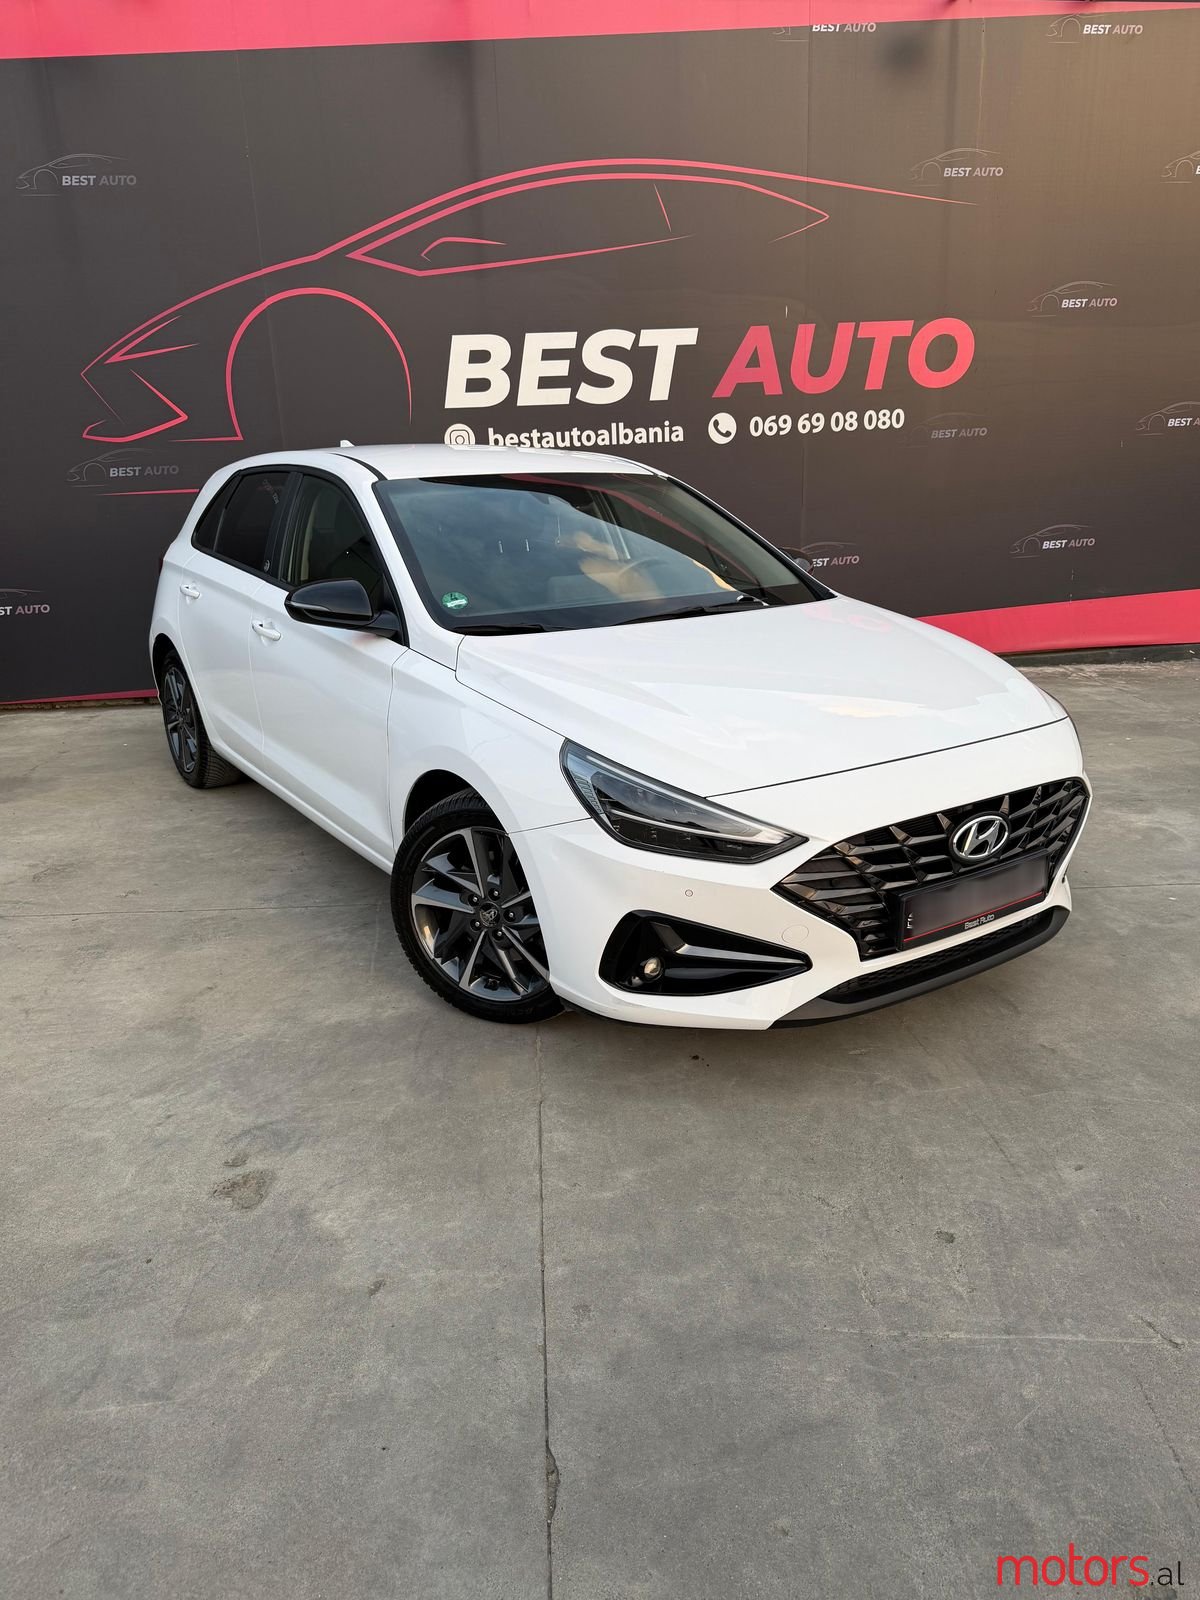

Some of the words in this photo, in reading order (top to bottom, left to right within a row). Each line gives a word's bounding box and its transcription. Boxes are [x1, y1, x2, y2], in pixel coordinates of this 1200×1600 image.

[811, 23, 841, 33] BEST
[844, 22, 876, 33] AUTO
[1082, 25, 1110, 35] BEST
[1112, 25, 1143, 35] AUTO
[943, 167, 971, 178] BEST
[972, 167, 1004, 177] AUTO
[61, 175, 96, 187] BEST
[99, 175, 137, 187] AUTO
[1061, 298, 1088, 309] BEST
[1089, 297, 1118, 308] AUTO
[444, 327, 698, 409] BEST
[713, 317, 976, 398] AUTO
[749, 413, 792, 437] 069
[797, 412, 826, 434] 69
[830, 411, 859, 433] 08
[863, 408, 905, 430] 080
[1167, 417, 1192, 428] BEST
[487, 419, 684, 448] bestautoalbania
[931, 428, 957, 440] BEST
[958, 427, 988, 438] AUTO
[109, 466, 142, 477] BEST
[144, 465, 179, 476] AUTO
[1042, 539, 1068, 550] BEST
[1069, 538, 1095, 548] AUTO
[812, 558, 829, 568] EST
[830, 555, 860, 567] AUTO
[0, 606, 12, 616] ST
[15, 604, 51, 615] AUTO
[964, 921, 979, 930] Best
[979, 913, 995, 925] Auto
